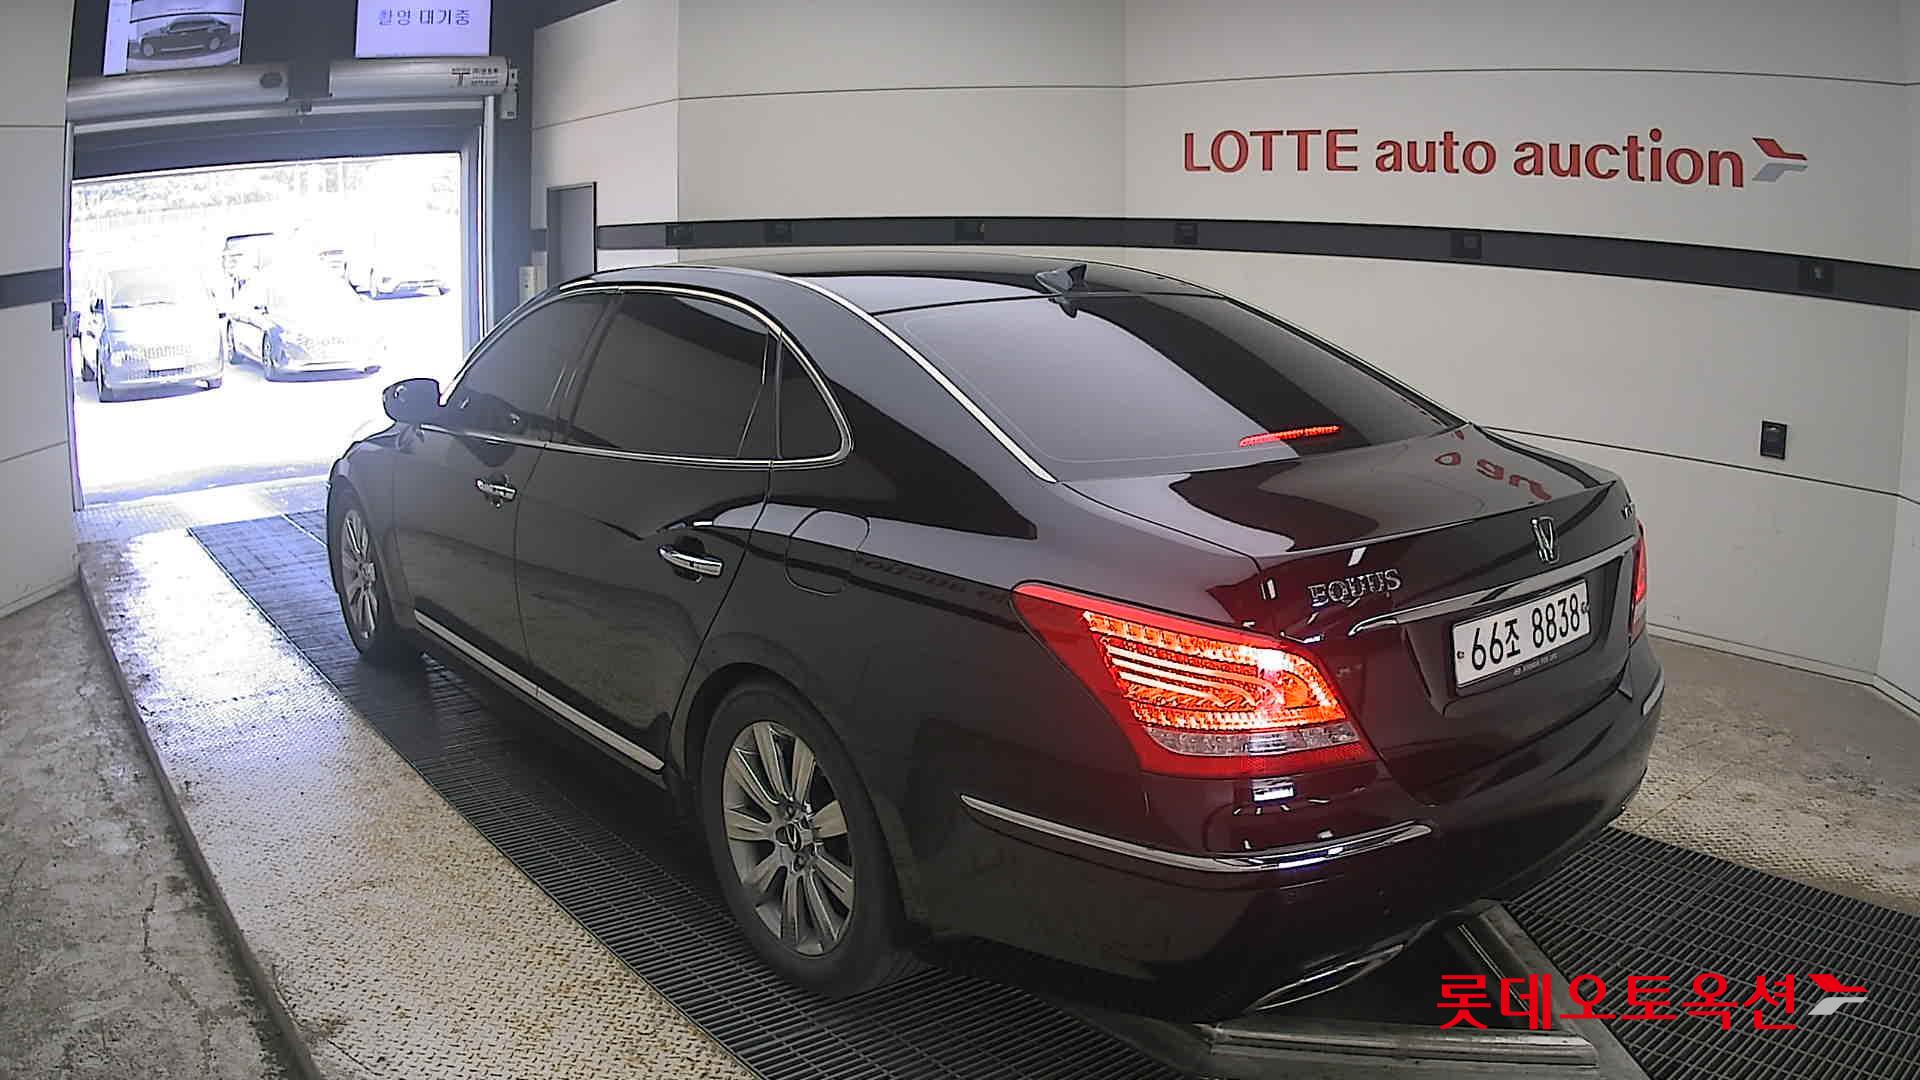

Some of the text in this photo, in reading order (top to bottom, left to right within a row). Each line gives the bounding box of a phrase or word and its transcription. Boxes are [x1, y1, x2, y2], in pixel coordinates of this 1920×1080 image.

[420, 8, 471, 26] 대기중
[1184, 129, 1745, 188] LOTTE auto auction
[1307, 569, 1401, 607] EQUUS
[1472, 618, 1521, 671] 66조
[1531, 593, 1580, 648] 8838
